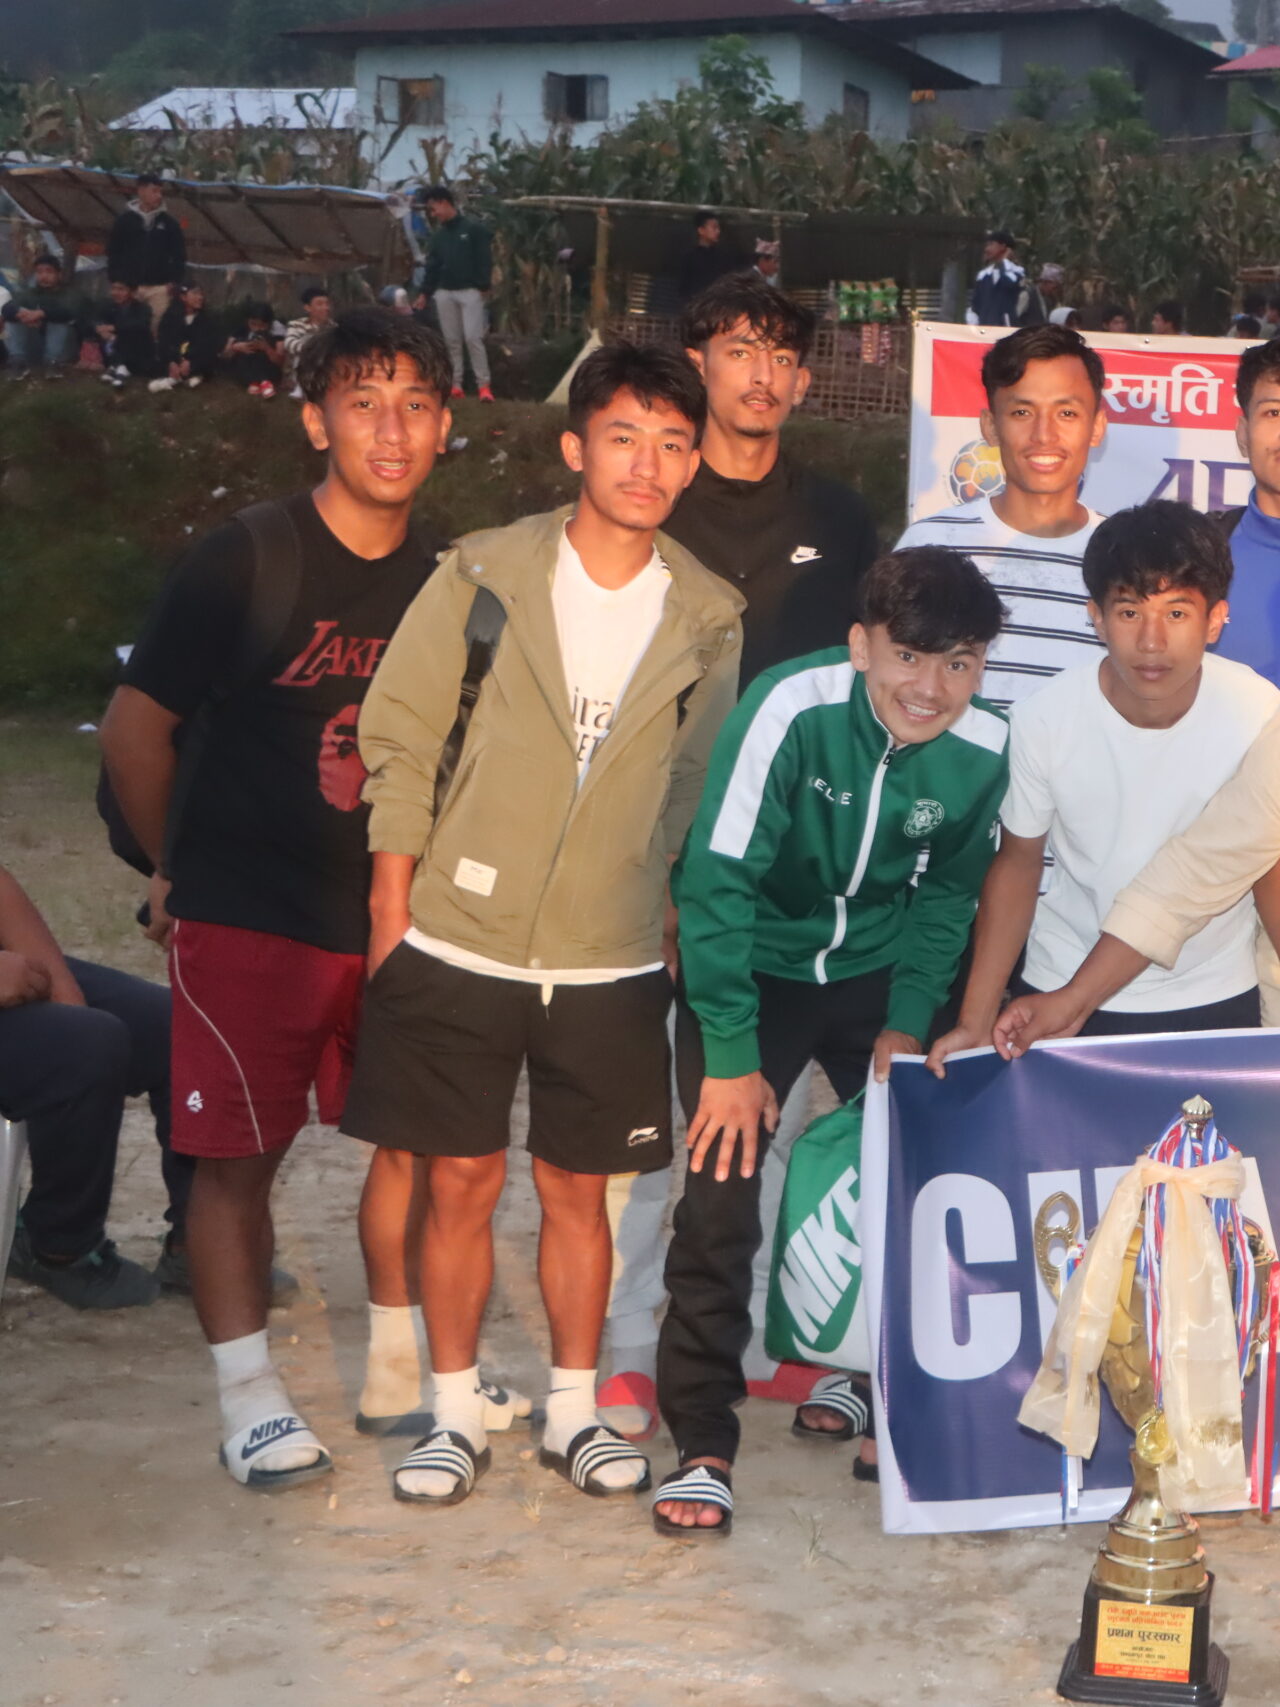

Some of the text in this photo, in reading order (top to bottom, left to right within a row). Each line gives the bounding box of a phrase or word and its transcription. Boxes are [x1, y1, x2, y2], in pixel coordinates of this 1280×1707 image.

[1102, 363, 1223, 424] स्मृति
[272, 620, 391, 687] LAKE
[249, 1416, 299, 1444] NIKE
